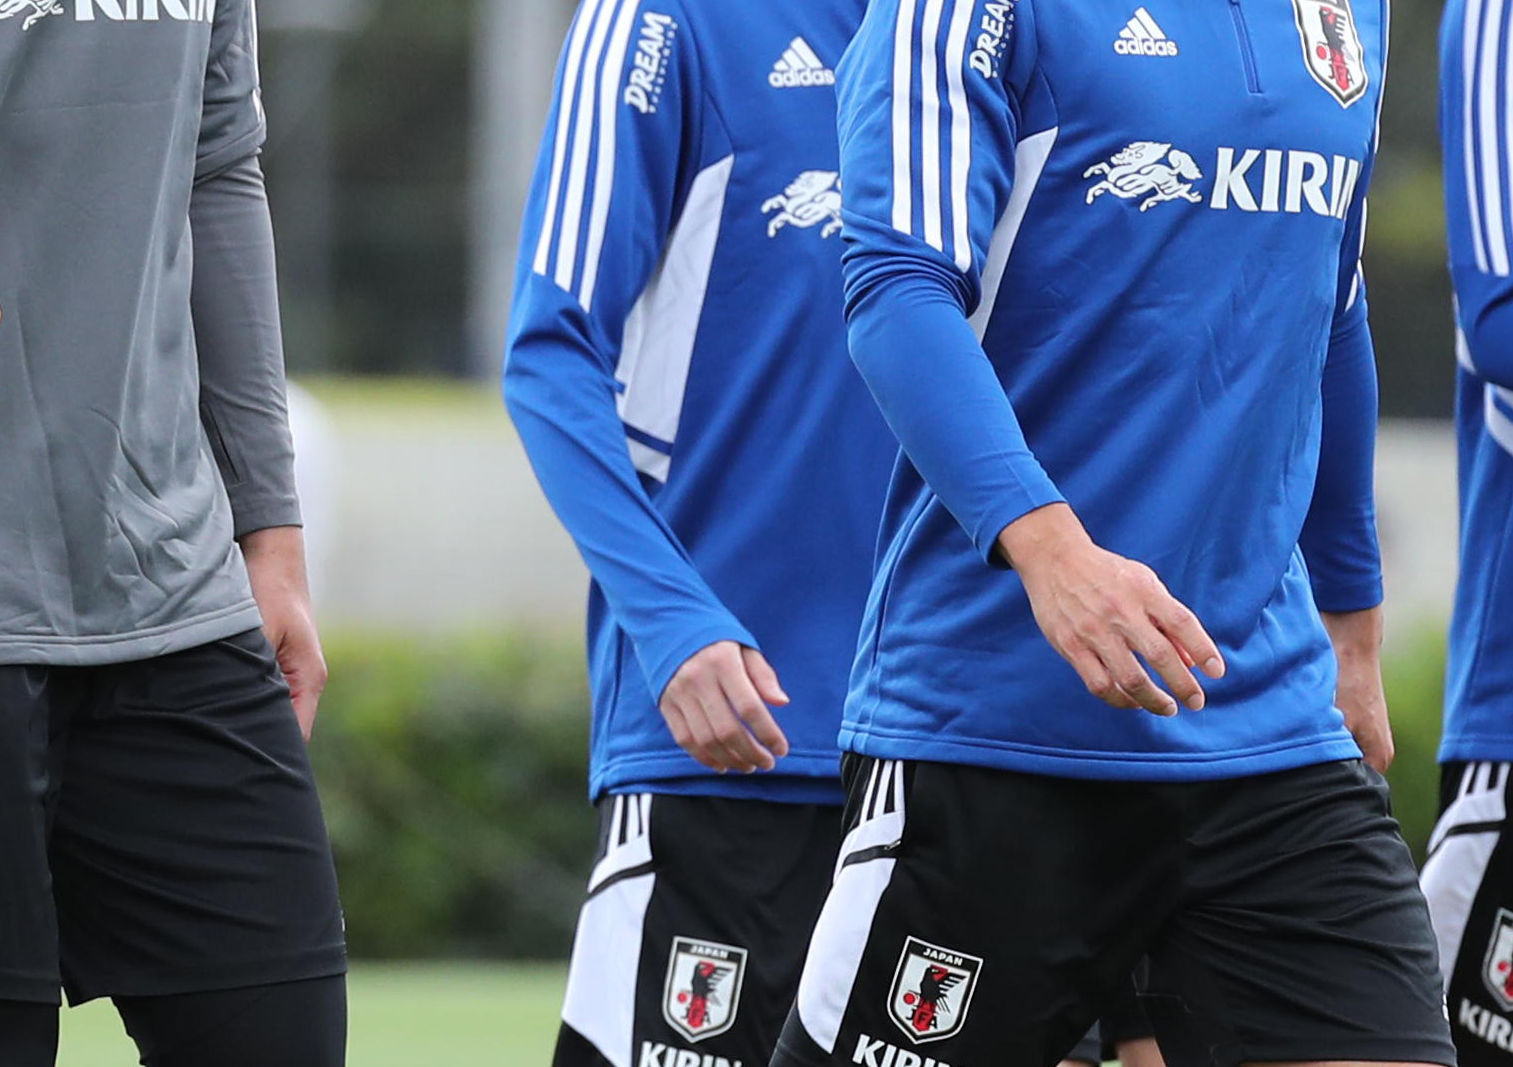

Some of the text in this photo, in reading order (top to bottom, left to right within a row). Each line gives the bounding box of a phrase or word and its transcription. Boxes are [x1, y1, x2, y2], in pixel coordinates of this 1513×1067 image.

[1113, 38, 1179, 57] adidas
[624, 12, 672, 114] DREAM
[768, 67, 836, 88] adidas
[690, 944, 729, 959] JAPAN
[923, 947, 964, 967] JAPAN
[1458, 997, 1513, 1054] KIR
[852, 1033, 954, 1067] KIR
